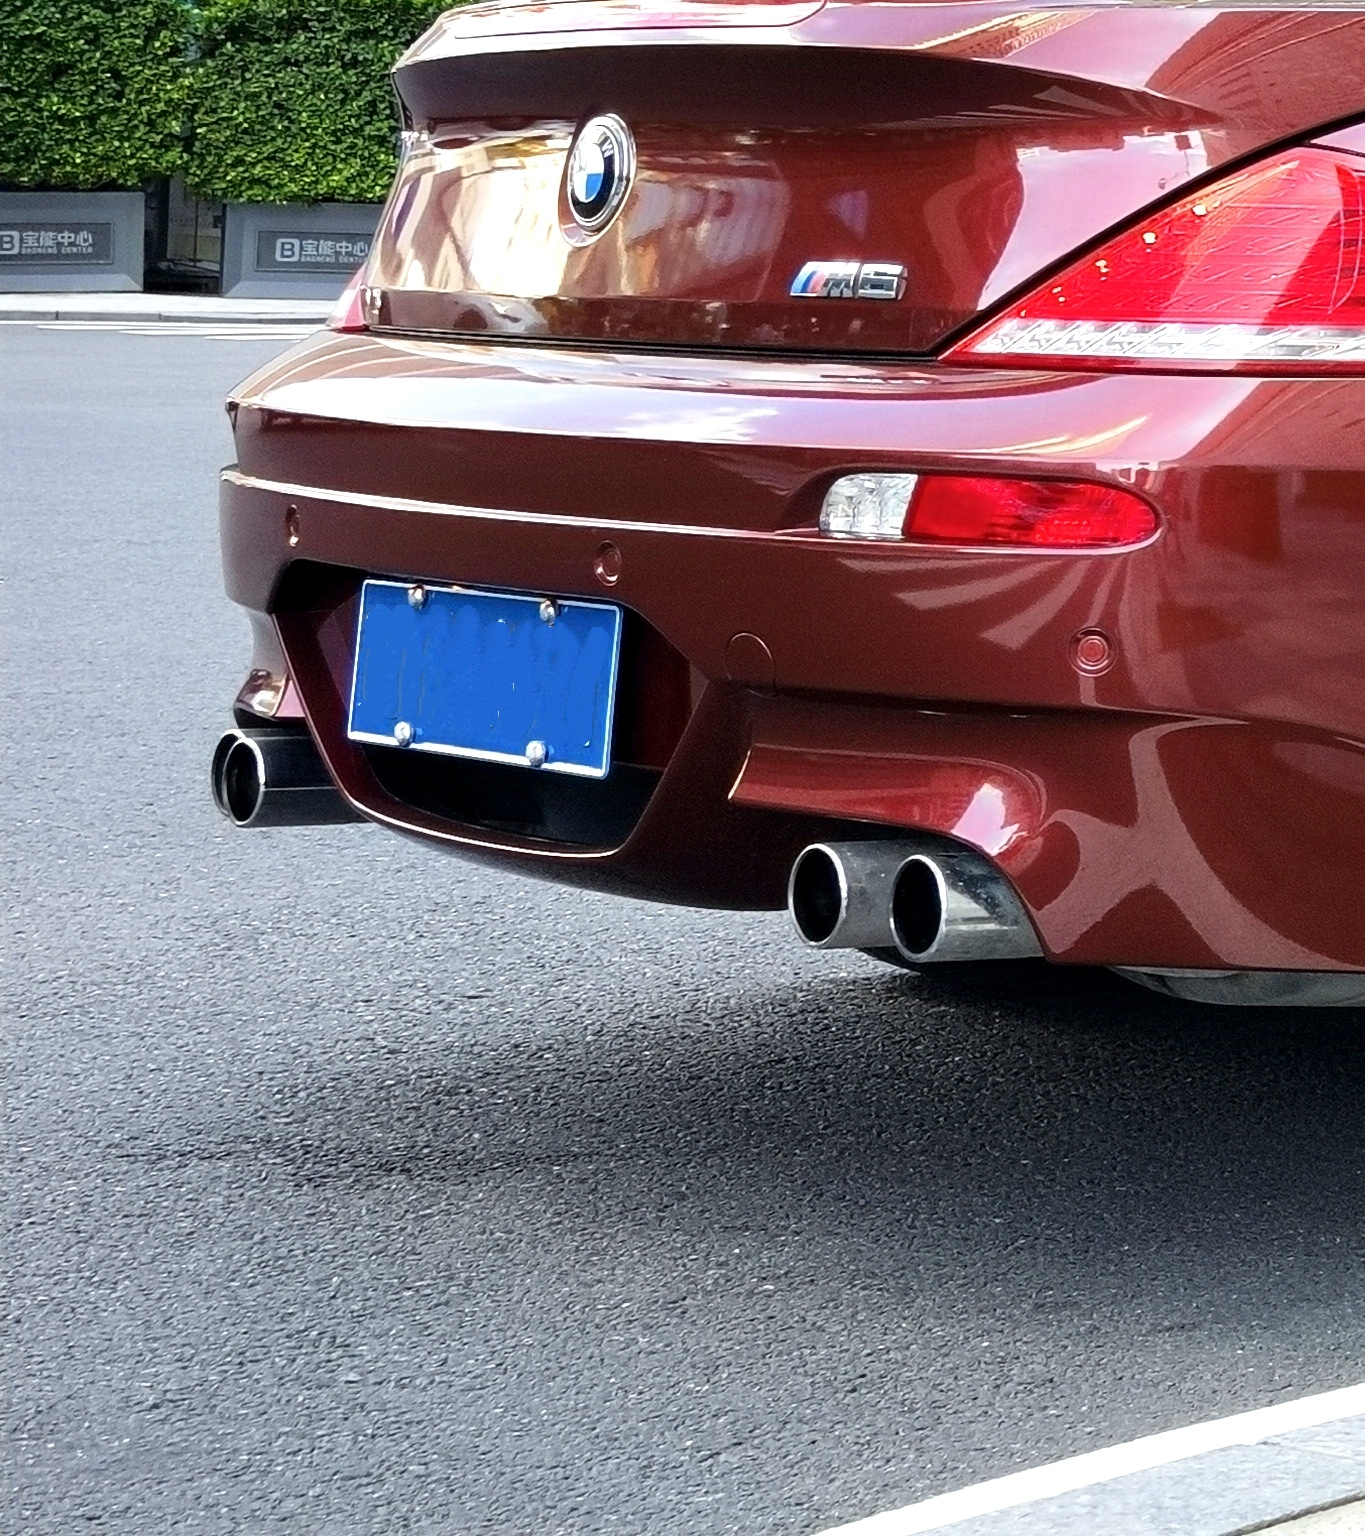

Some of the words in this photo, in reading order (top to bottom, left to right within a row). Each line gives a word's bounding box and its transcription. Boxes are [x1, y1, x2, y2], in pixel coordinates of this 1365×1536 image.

[22, 230, 93, 246] 宝能中心
[302, 240, 368, 257] 宝能中心
